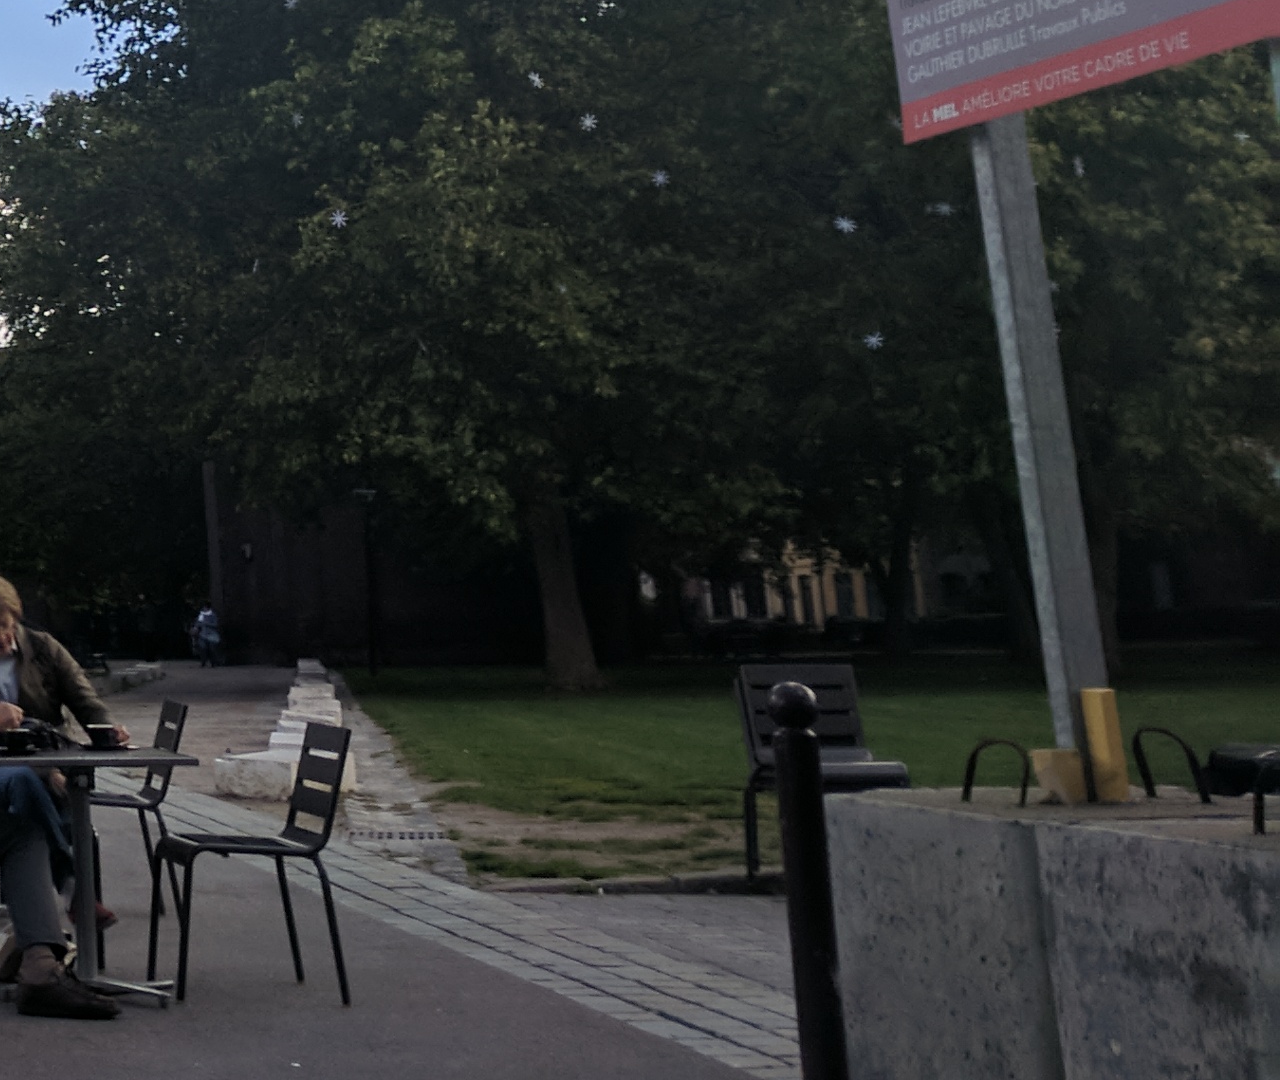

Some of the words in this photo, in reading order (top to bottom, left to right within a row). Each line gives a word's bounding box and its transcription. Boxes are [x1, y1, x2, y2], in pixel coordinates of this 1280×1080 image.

[959, 5, 1012, 40] PAVAGE
[1030, 18, 1079, 42] Travaux
[913, 110, 930, 129] LA
[960, 79, 1031, 113] AMÉLIORE
[1034, 65, 1081, 93] VOTRE
[1083, 48, 1136, 78] CADRE
[1138, 39, 1161, 61] DE
[1163, 31, 1189, 54] VIE
